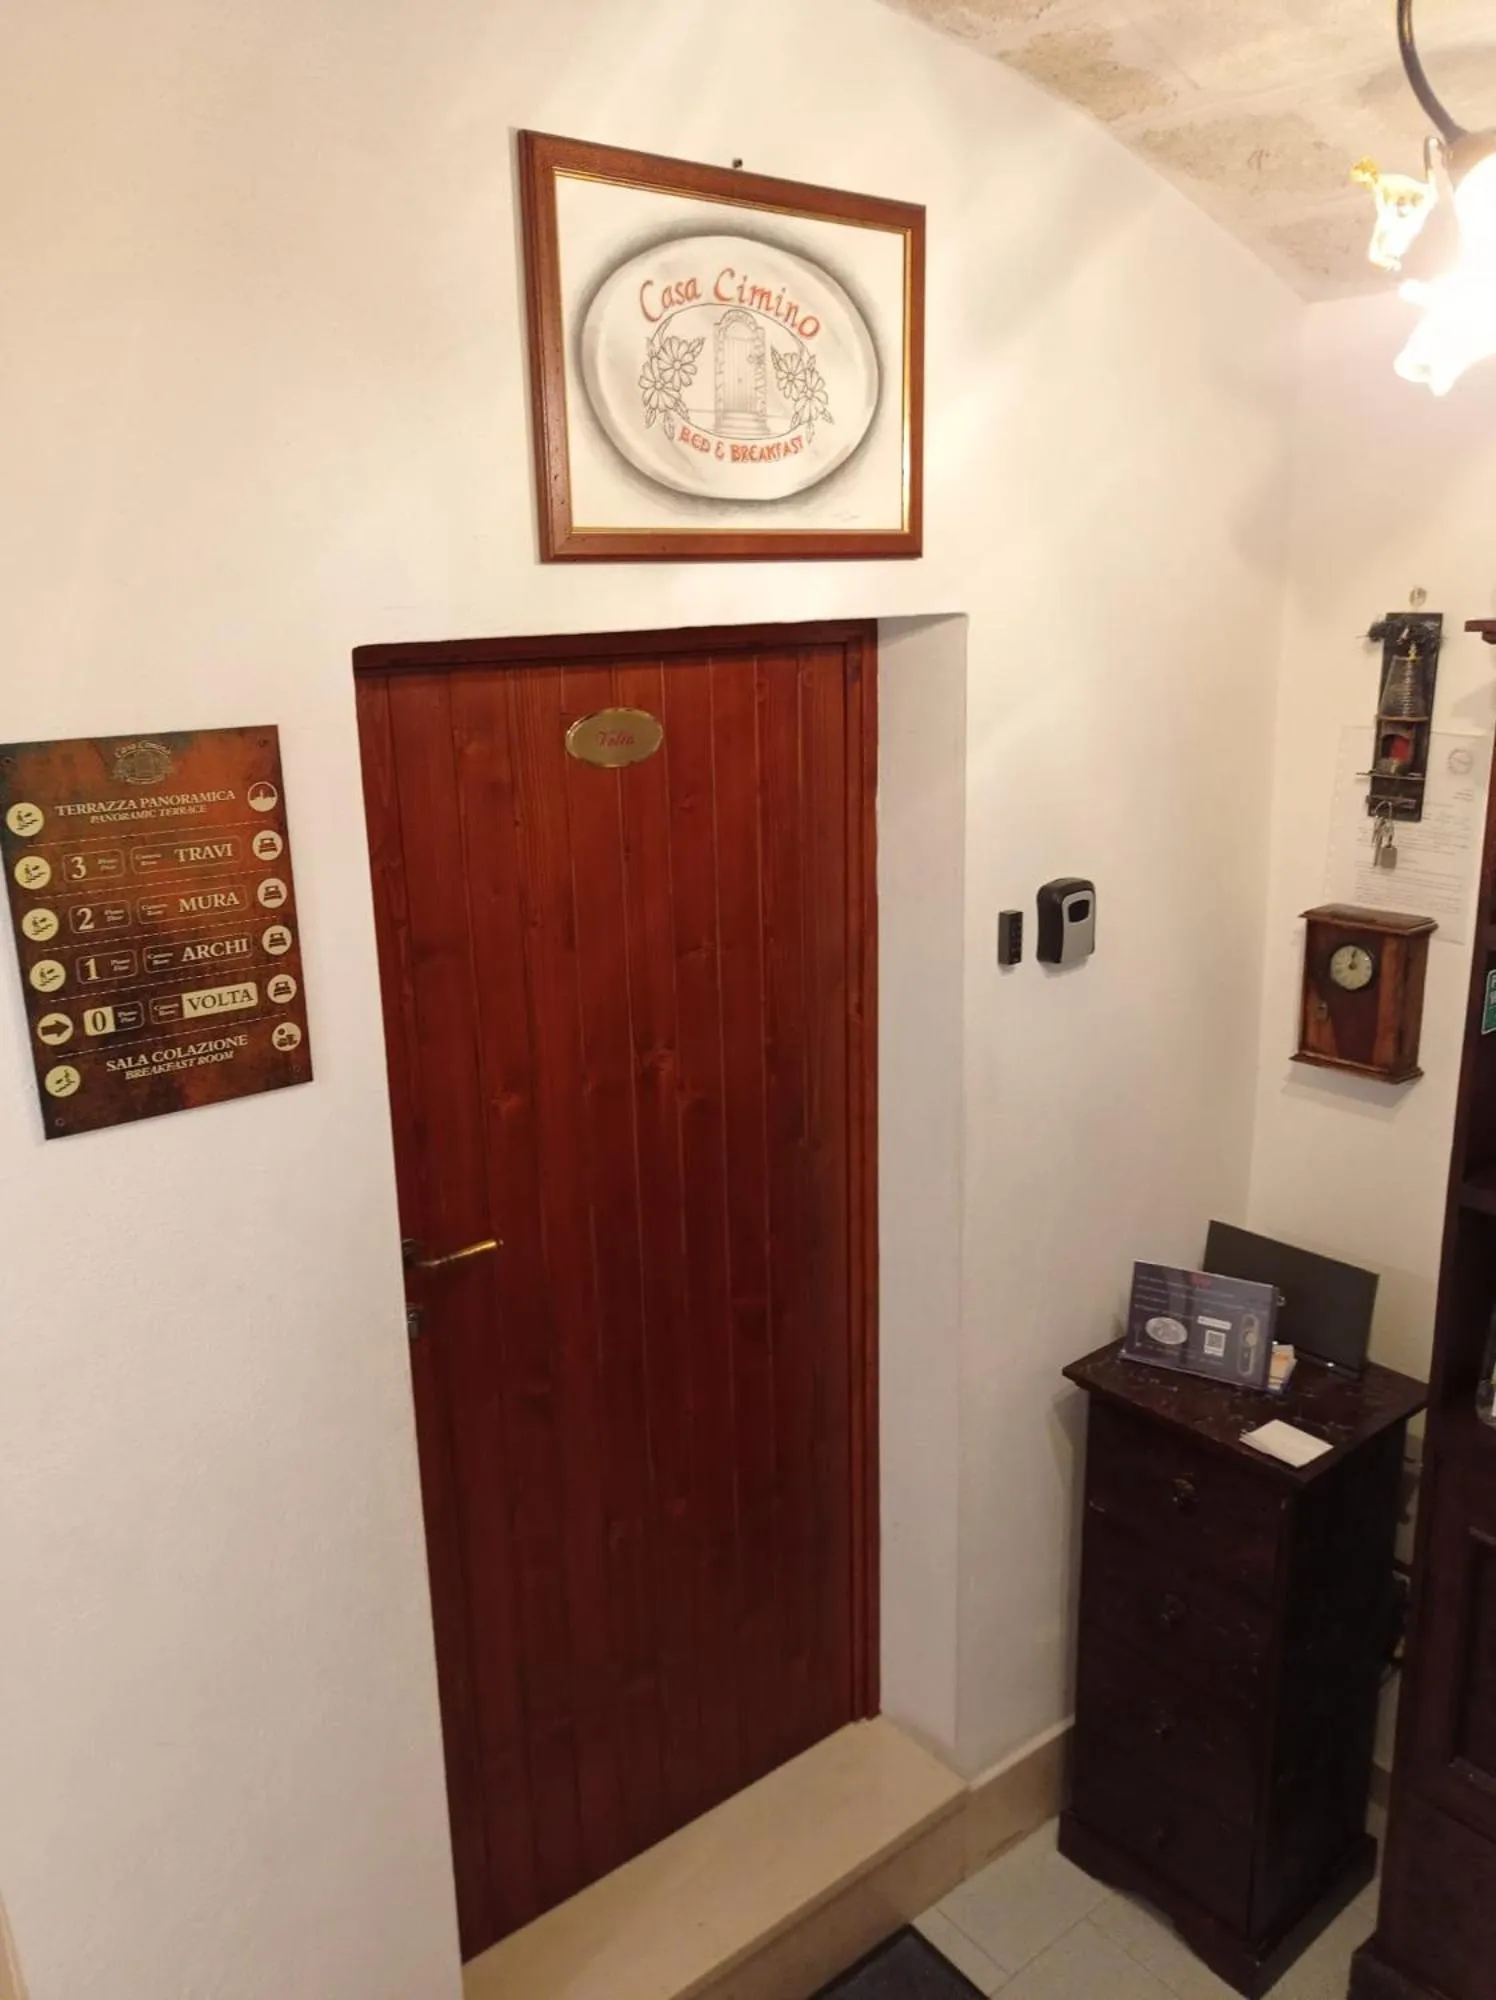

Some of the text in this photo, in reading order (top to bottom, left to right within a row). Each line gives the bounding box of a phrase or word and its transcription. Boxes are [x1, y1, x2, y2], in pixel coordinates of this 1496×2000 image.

[639, 267, 820, 341] Casa Cimino
[678, 426, 711, 454] BED
[730, 436, 804, 463] BREAKFAST
[54, 790, 236, 817] TERRAZZA PANORAMICA
[90, 804, 207, 824] PANORAMIC TERRACE
[174, 843, 233, 863] TRAVI
[71, 856, 87, 880] 3
[179, 891, 240, 913] MURA
[76, 907, 95, 931] 2
[181, 938, 249, 962] ARCHI
[84, 958, 99, 981] 1
[188, 988, 254, 1011] VOLTA
[92, 1010, 106, 1032] 0
[106, 1034, 248, 1072] SALA COLAZIONE
[125, 1050, 234, 1080] BREAKFAST ROOM
